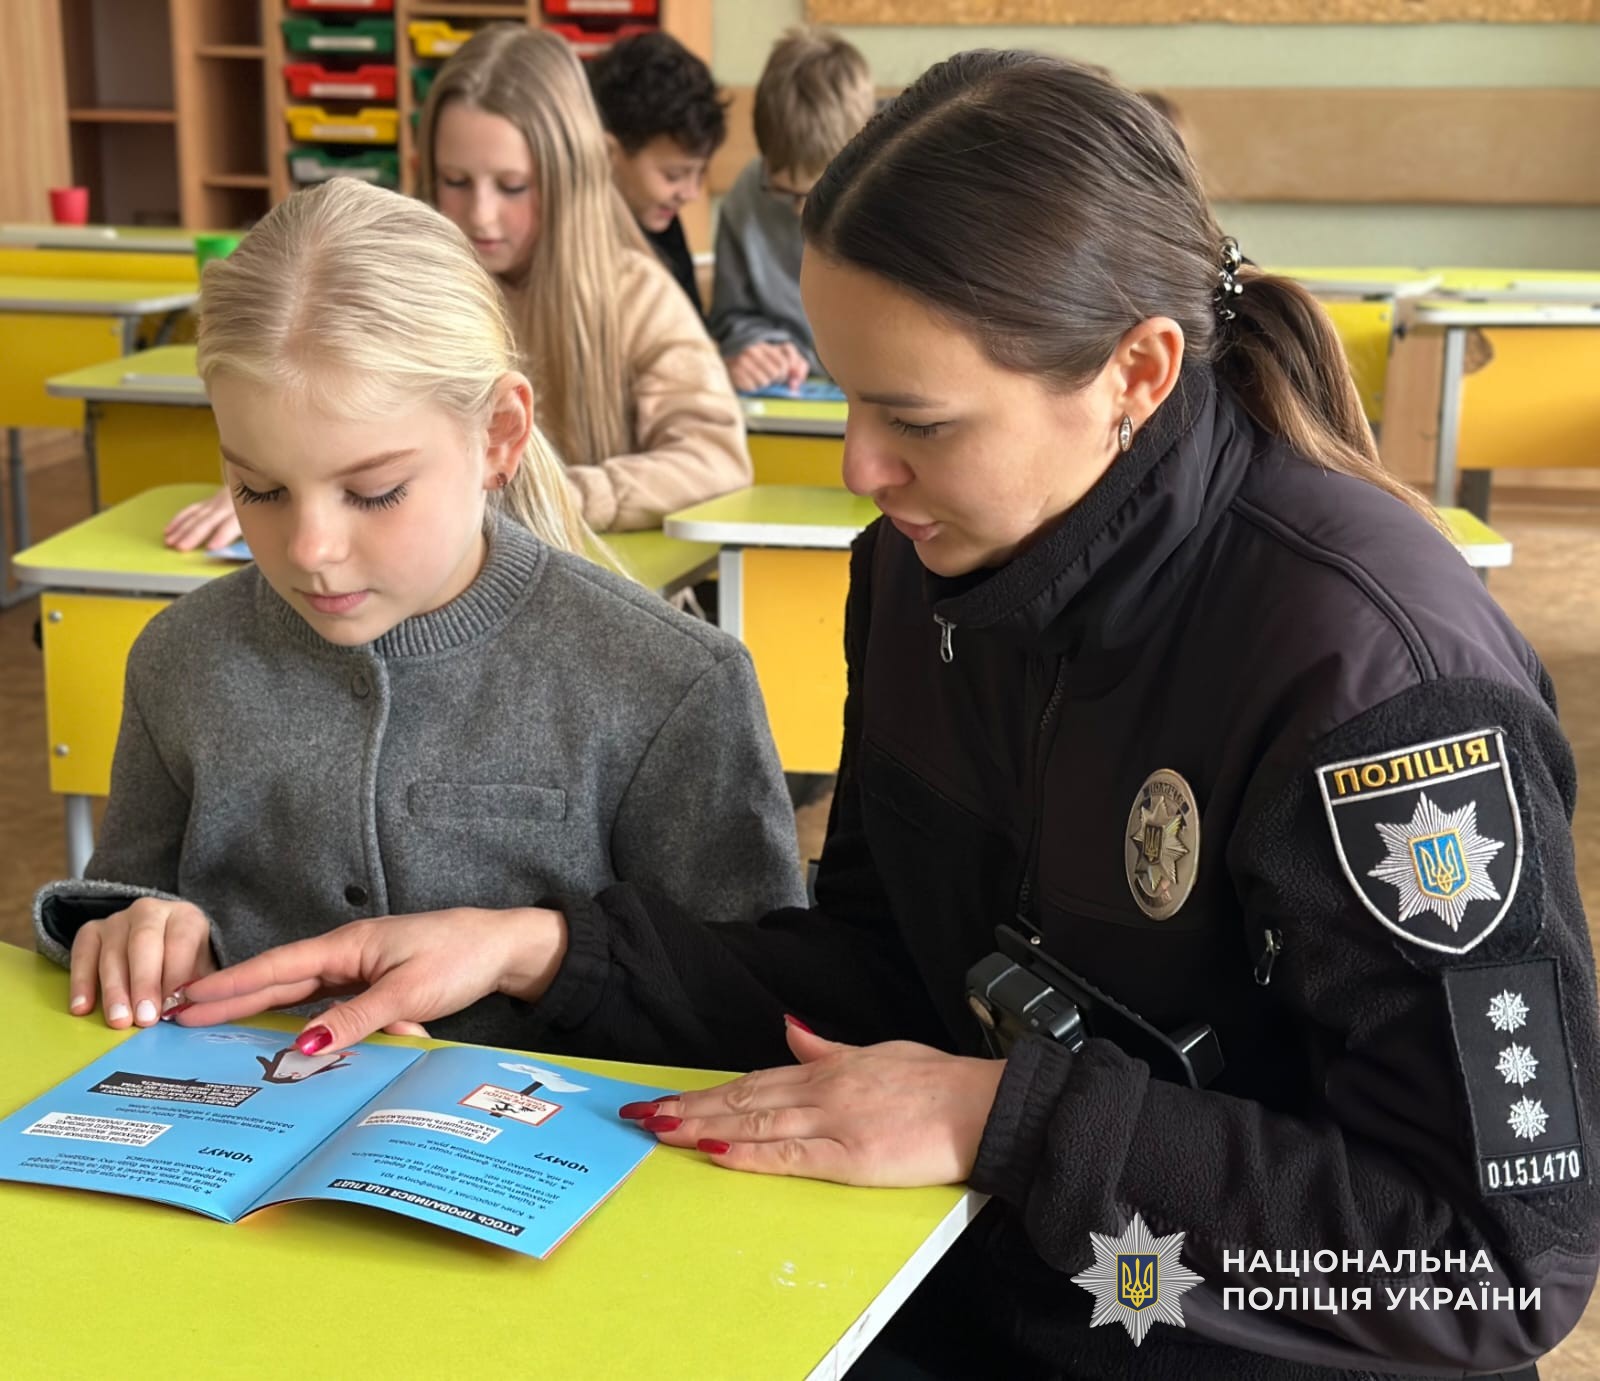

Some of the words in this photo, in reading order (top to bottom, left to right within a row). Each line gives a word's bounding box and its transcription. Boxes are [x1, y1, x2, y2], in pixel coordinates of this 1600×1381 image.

[1333, 738, 1490, 795] ПОЛІЦІЯ
[198, 1146, 253, 1163] ЧОМУ?
[534, 1152, 589, 1173] ЧОМУ?
[1487, 1150, 1581, 1190] 0151470
[332, 1180, 366, 1190] ЛІД?
[364, 1184, 390, 1195] ПІД
[390, 1189, 476, 1220] ПРОВАЛИВСЯ
[475, 1215, 520, 1234] ХТОСЬ
